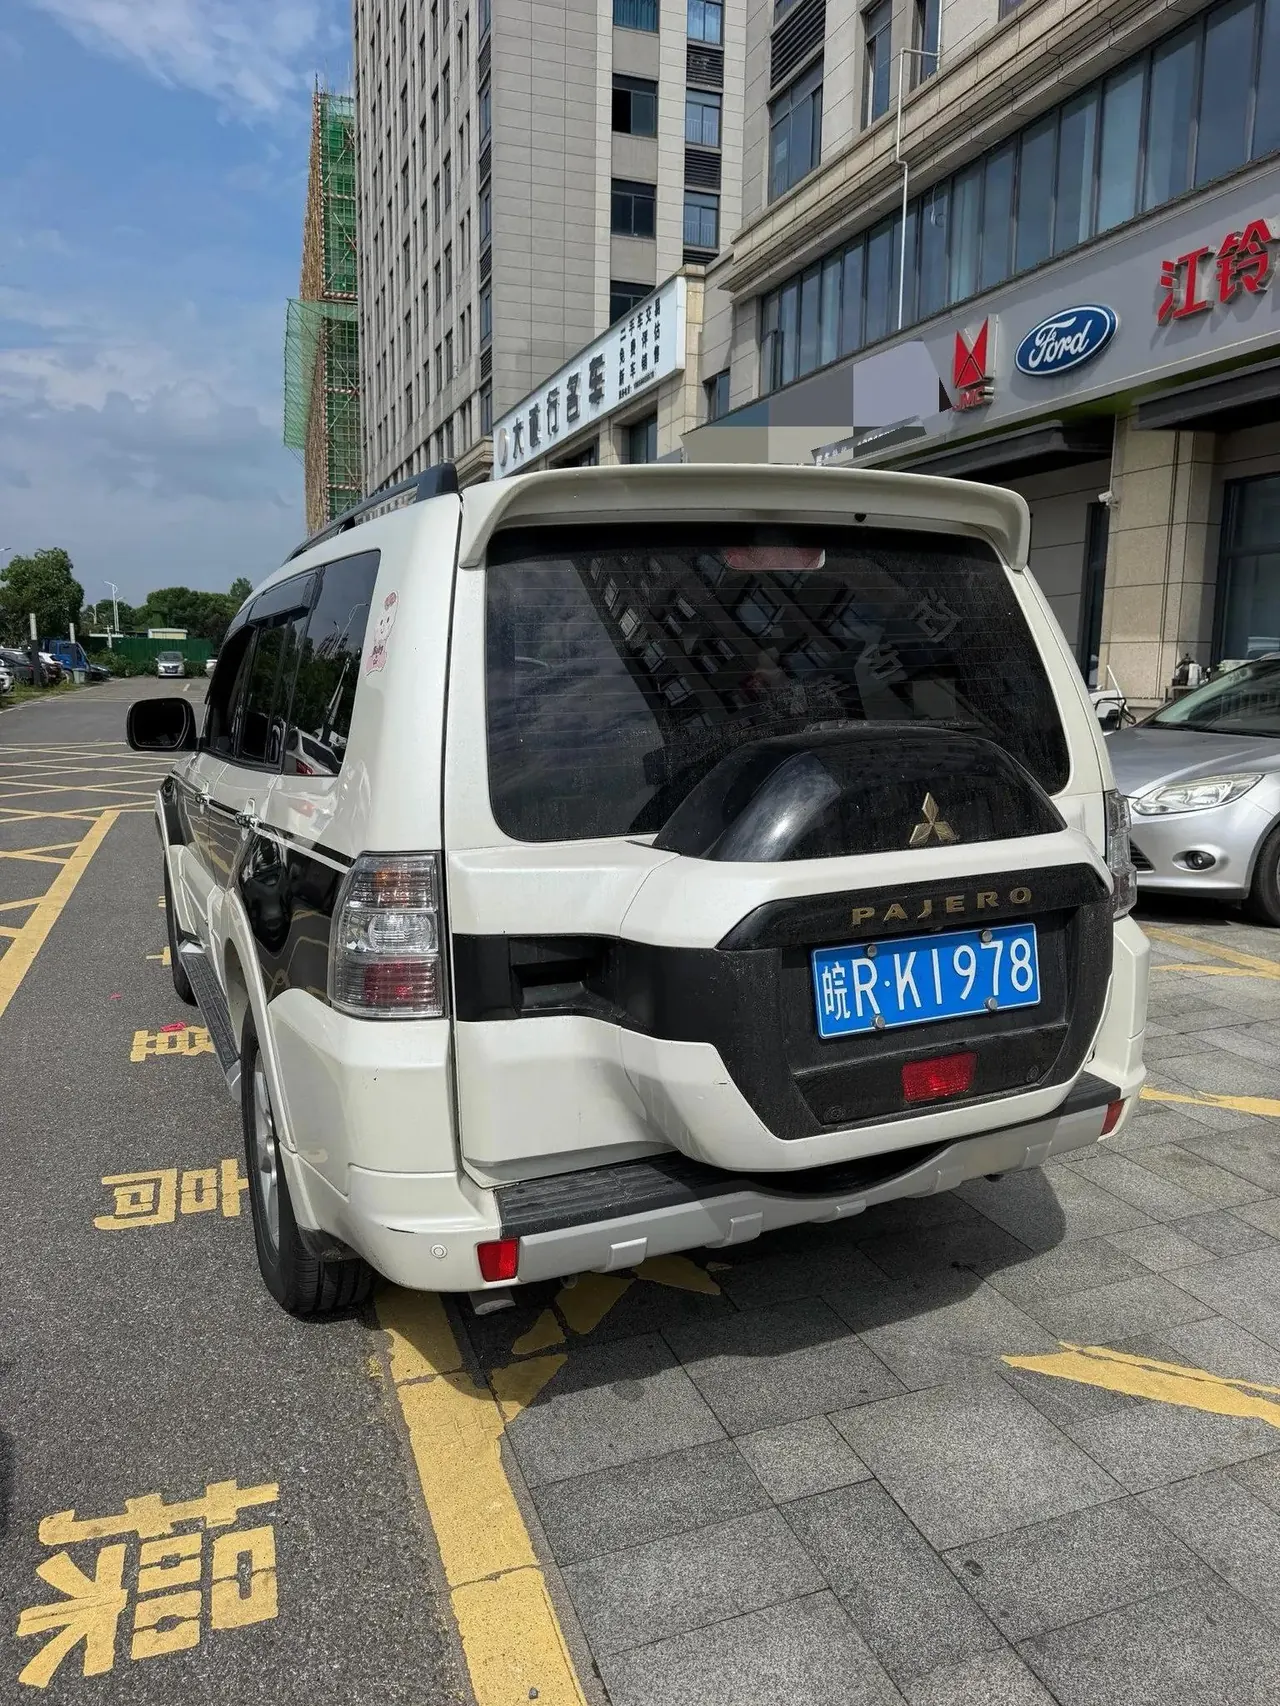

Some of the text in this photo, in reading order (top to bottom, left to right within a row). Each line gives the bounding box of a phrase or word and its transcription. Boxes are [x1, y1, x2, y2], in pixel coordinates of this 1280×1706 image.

[1157, 218, 1271, 322] 江铃
[1028, 316, 1093, 368] Ford
[952, 385, 990, 411] JMC
[851, 886, 1033, 926] PAJERO
